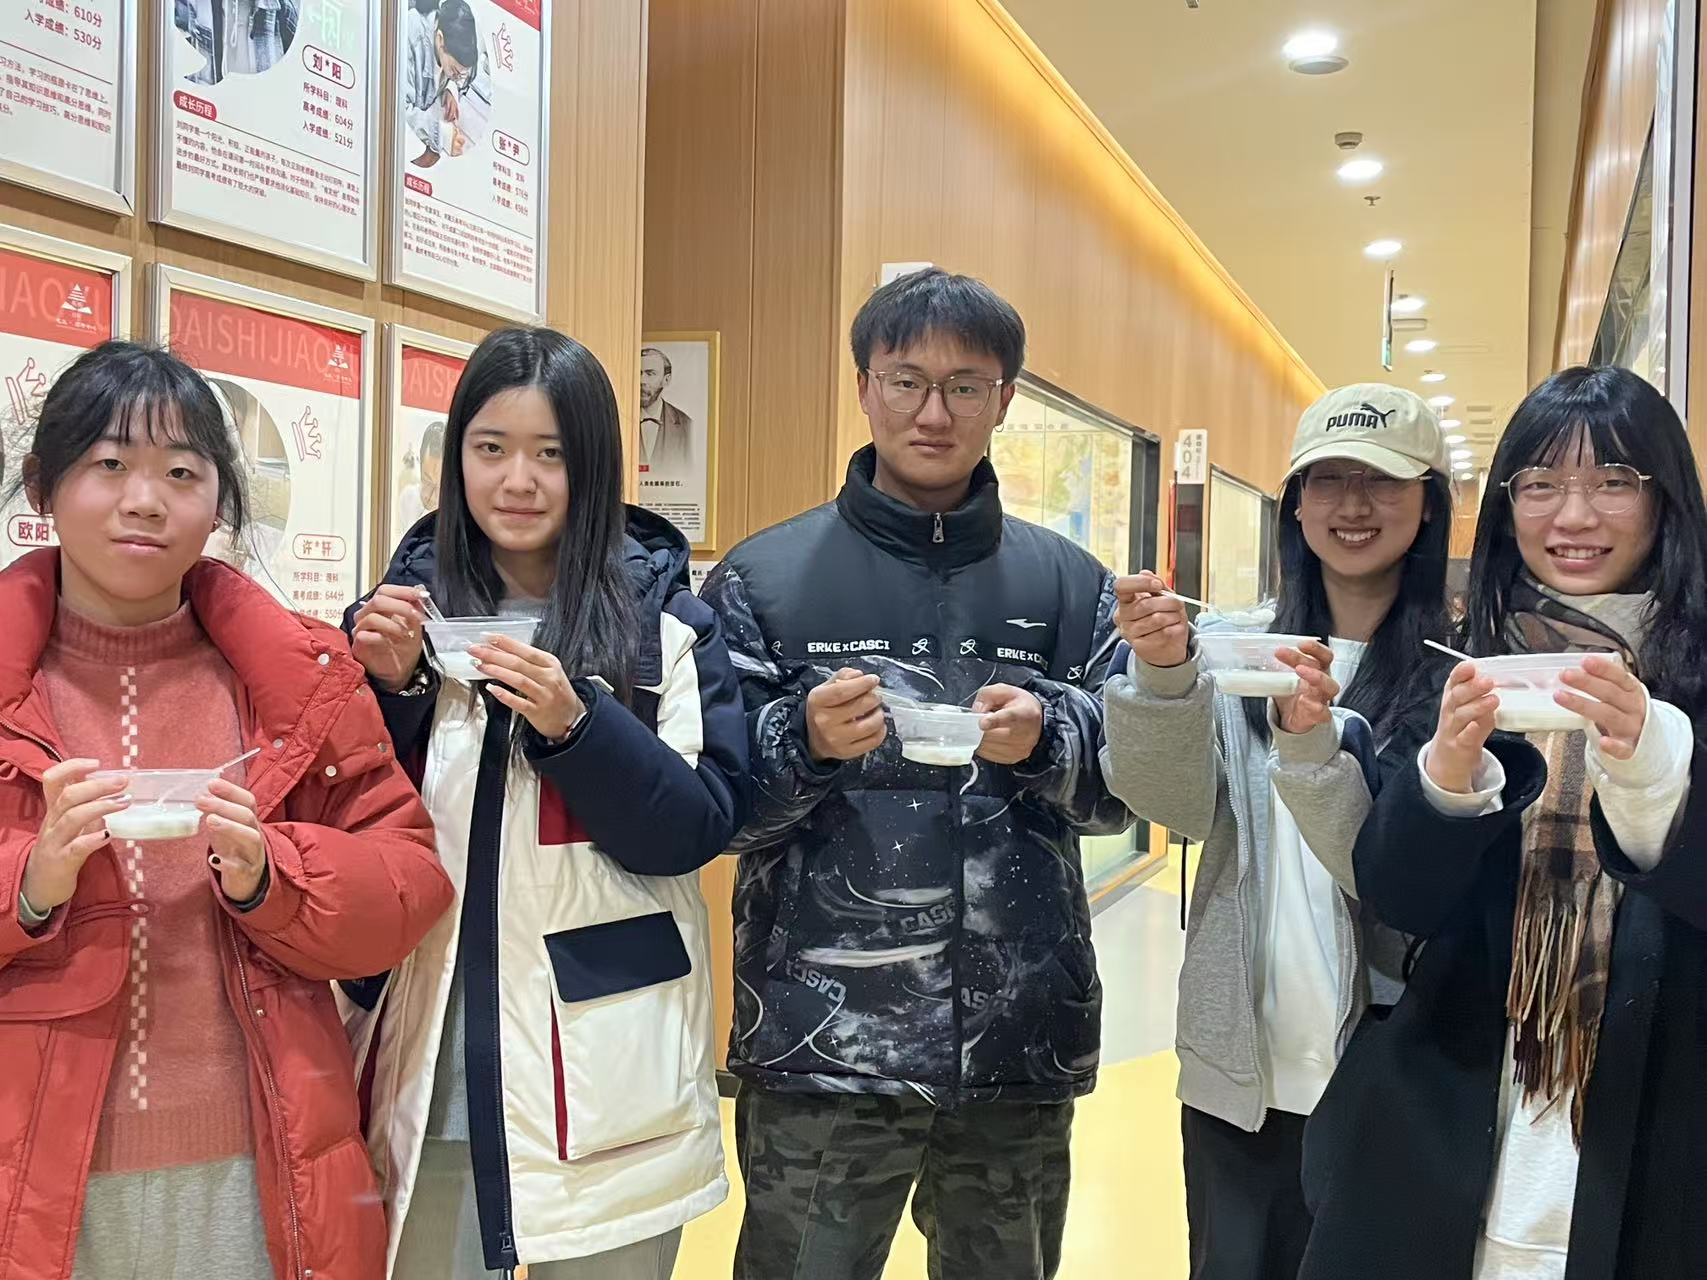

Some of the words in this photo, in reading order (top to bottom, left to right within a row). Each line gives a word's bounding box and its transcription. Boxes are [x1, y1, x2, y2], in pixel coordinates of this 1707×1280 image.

[25, 9, 102, 50] 入学成绩：530分
[179, 95, 213, 117] 成长历程
[303, 101, 353, 130] 高考成绩：604分
[303, 121, 353, 149] 入学成绩：521分
[1326, 413, 1378, 431] PUMA
[293, 590, 344, 601] 高考成绩：644分
